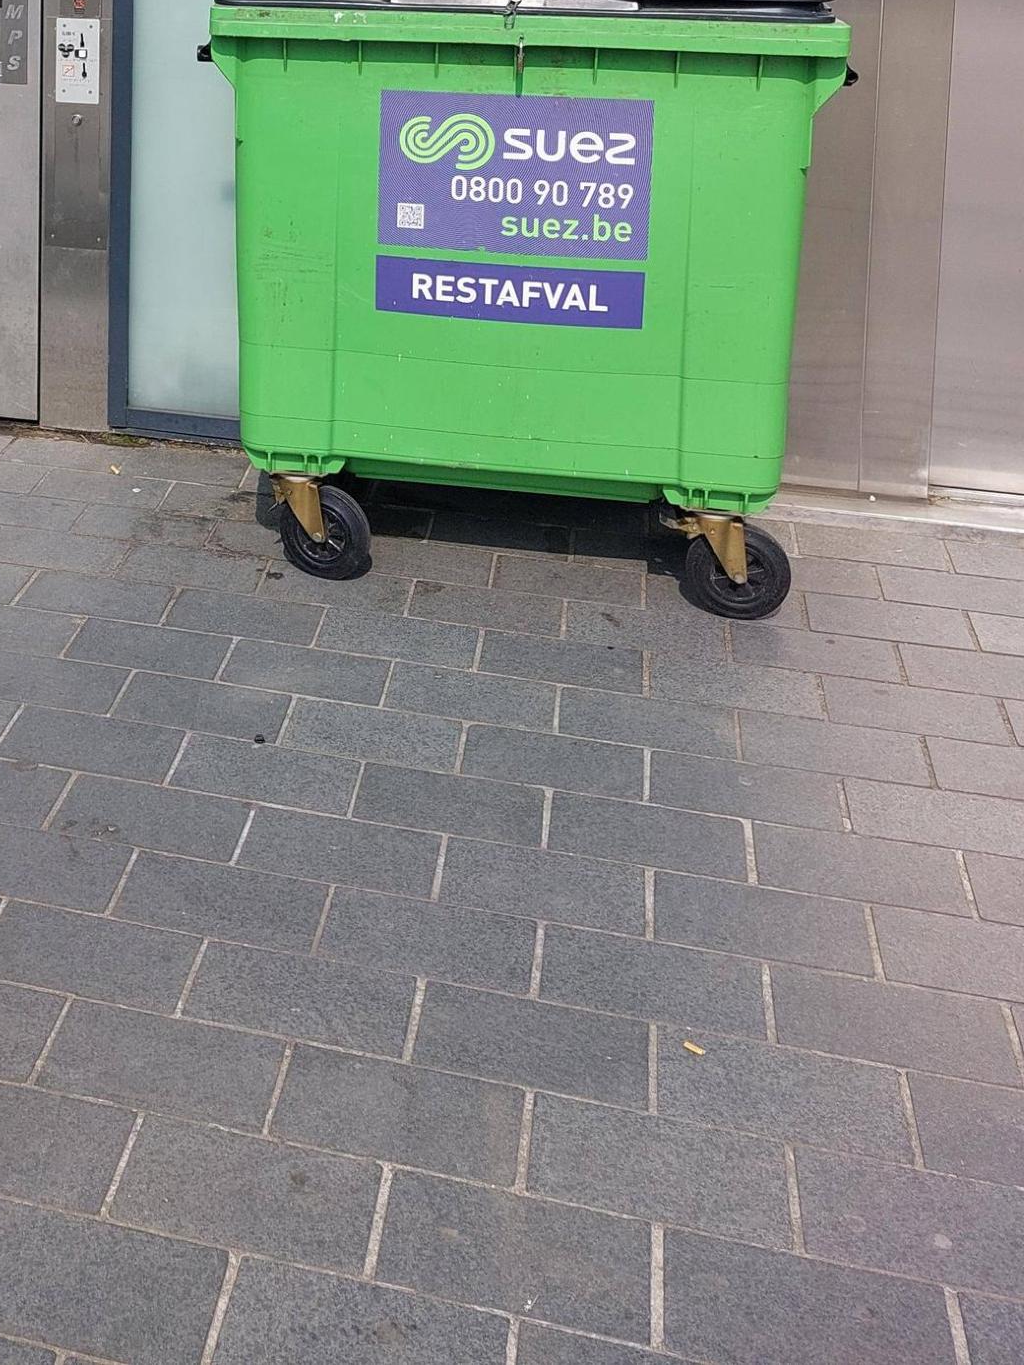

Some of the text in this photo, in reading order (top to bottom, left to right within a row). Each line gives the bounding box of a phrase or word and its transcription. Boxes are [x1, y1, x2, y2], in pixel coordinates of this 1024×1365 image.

[450, 174, 635, 210] 0800 90 789
[501, 213, 633, 243] suez.be
[411, 272, 609, 312] RESTAFVAL
